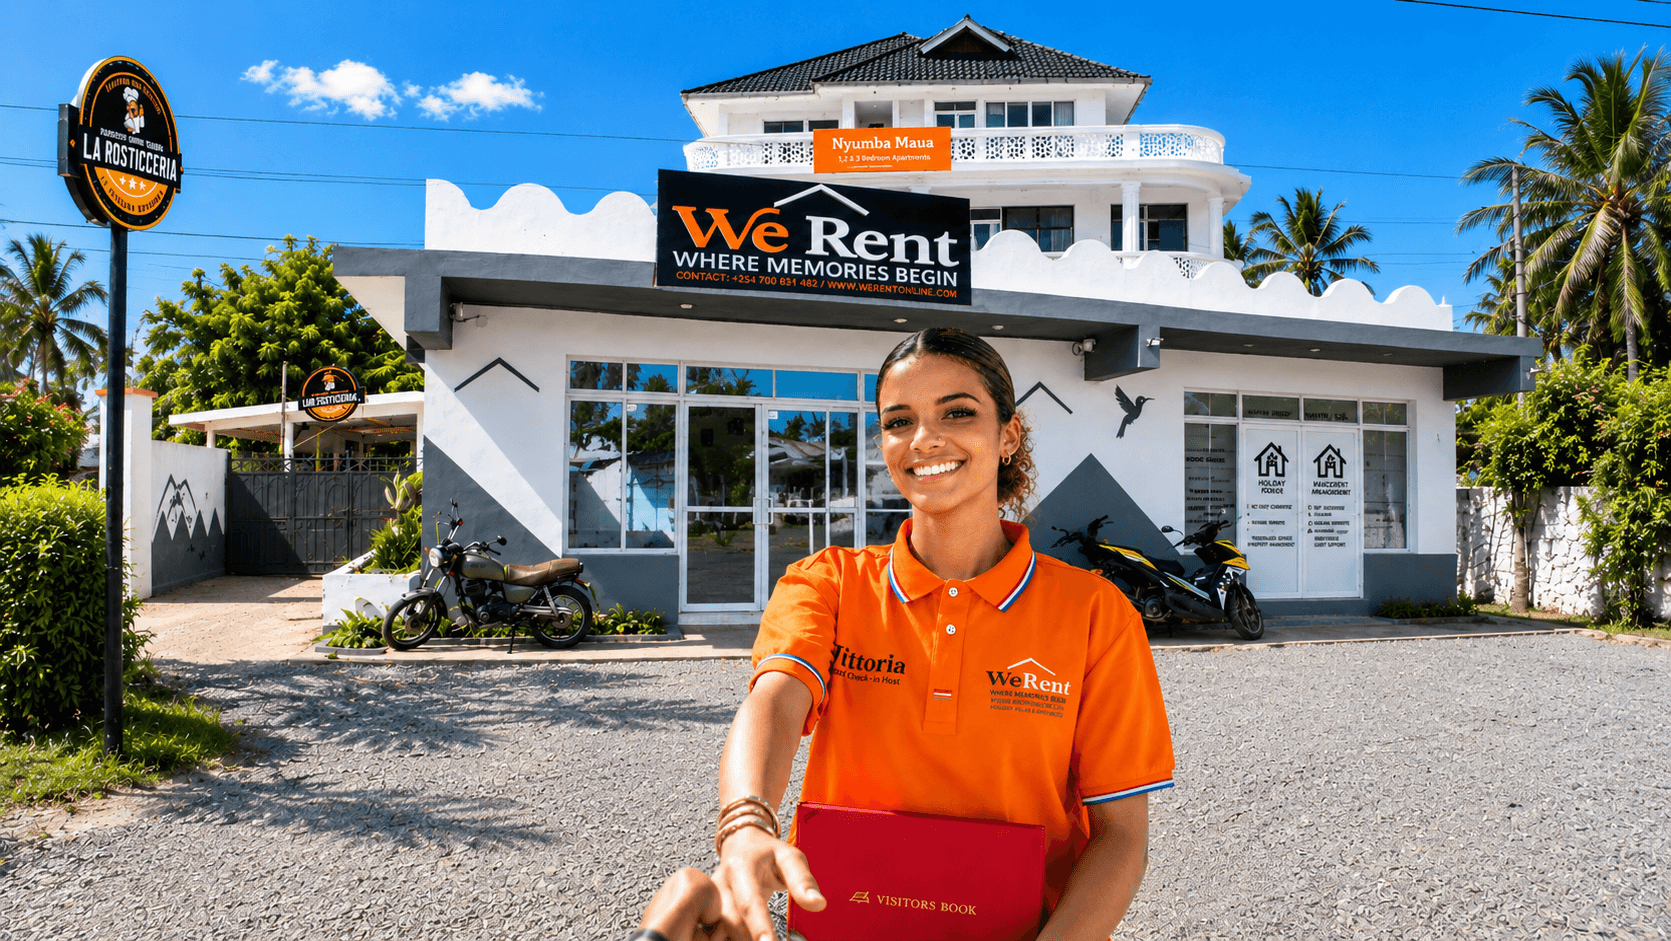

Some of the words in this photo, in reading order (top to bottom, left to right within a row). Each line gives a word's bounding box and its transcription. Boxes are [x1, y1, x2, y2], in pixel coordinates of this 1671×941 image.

[832, 136, 891, 153] Nyumba
[895, 136, 934, 149] Maua
[83, 132, 101, 162] LA
[104, 140, 177, 182] ROSTICCERIA
[861, 154, 890, 162] Bedroom
[892, 154, 931, 163] Apartments
[671, 205, 789, 253] We
[804, 215, 960, 267] Rent
[672, 250, 759, 272] WHERE
[767, 257, 889, 281] MEMORIES
[895, 267, 957, 287] BEGIN
[676, 271, 730, 282] CONTACT:
[732, 274, 756, 284] +254
[759, 275, 777, 285] 700
[877, 894, 936, 911] VISITORS
[940, 901, 977, 916] BOOK
